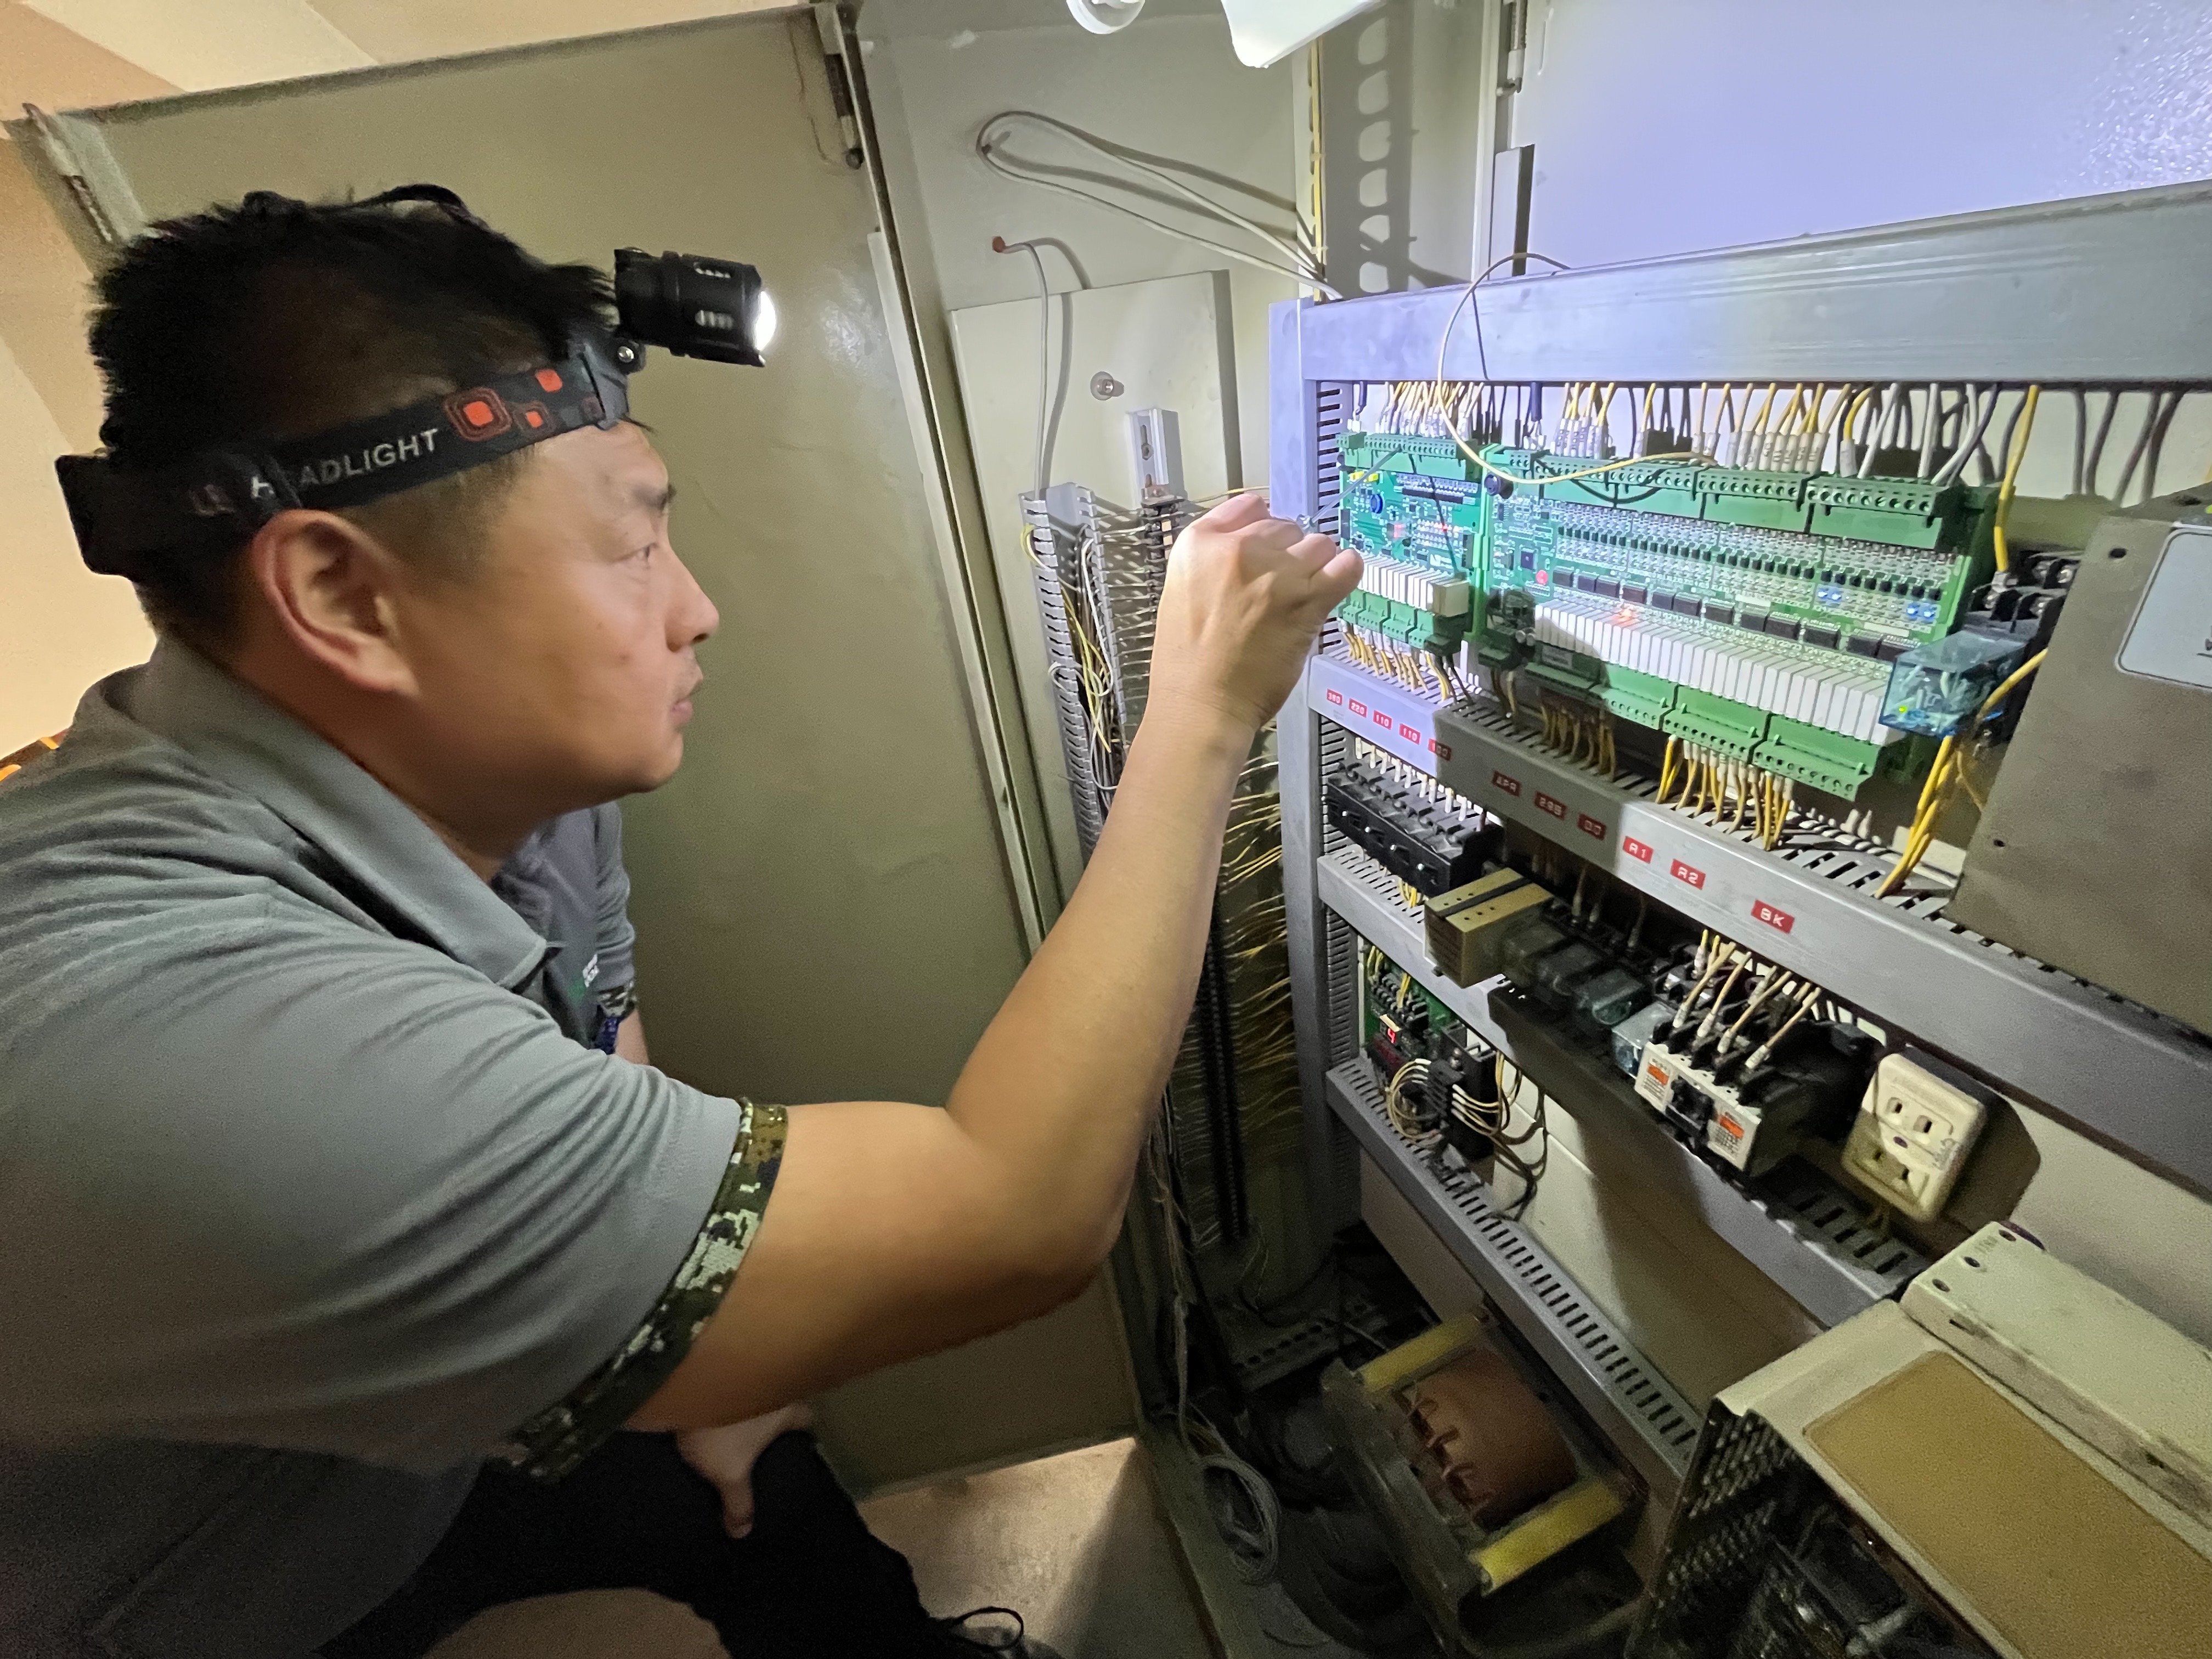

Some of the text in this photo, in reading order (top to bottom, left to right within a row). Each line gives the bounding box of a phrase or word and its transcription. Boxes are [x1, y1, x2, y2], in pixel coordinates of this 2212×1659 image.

[249, 427, 439, 499] HADLIGHT
[1350, 702, 1365, 715] 220
[1375, 714, 1390, 727] 110
[1402, 727, 1418, 742] 110
[1628, 842, 1646, 859] R1
[1677, 866, 1699, 885] R2
